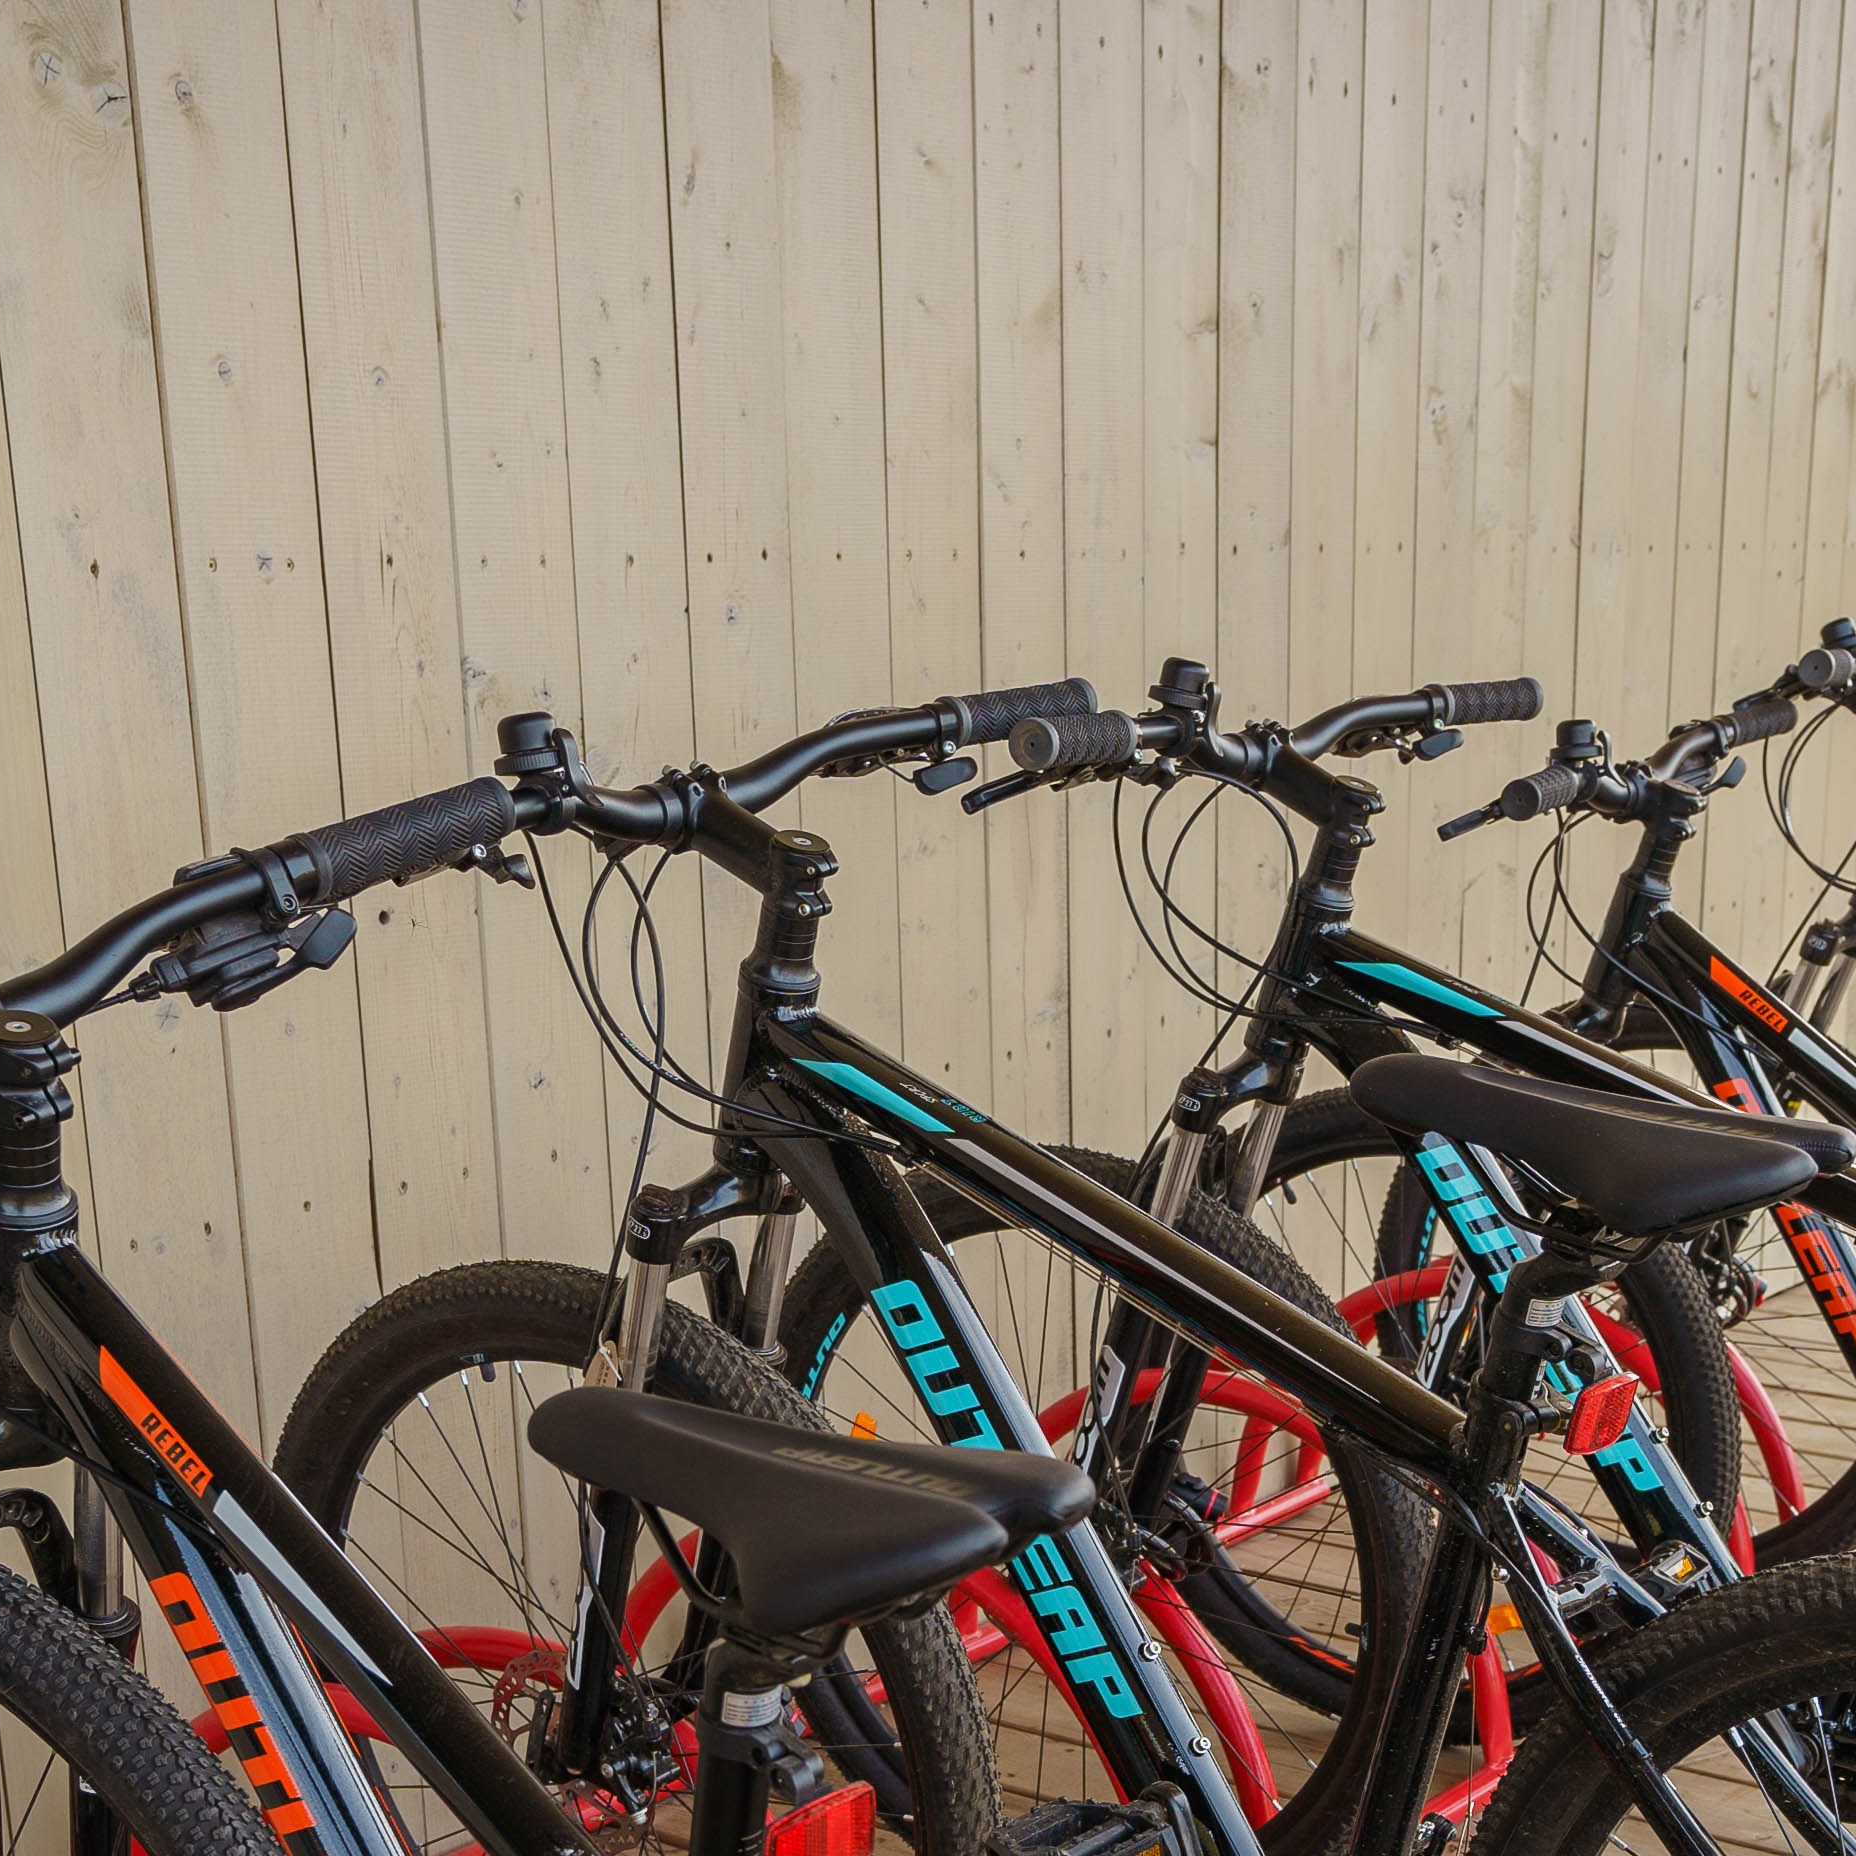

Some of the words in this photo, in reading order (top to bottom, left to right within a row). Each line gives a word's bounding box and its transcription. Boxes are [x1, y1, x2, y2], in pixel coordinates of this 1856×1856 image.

[1739, 990, 1784, 1028] REBEL
[141, 1412, 207, 1493] REBEL
[871, 1279, 1143, 1719] OUTEAP
